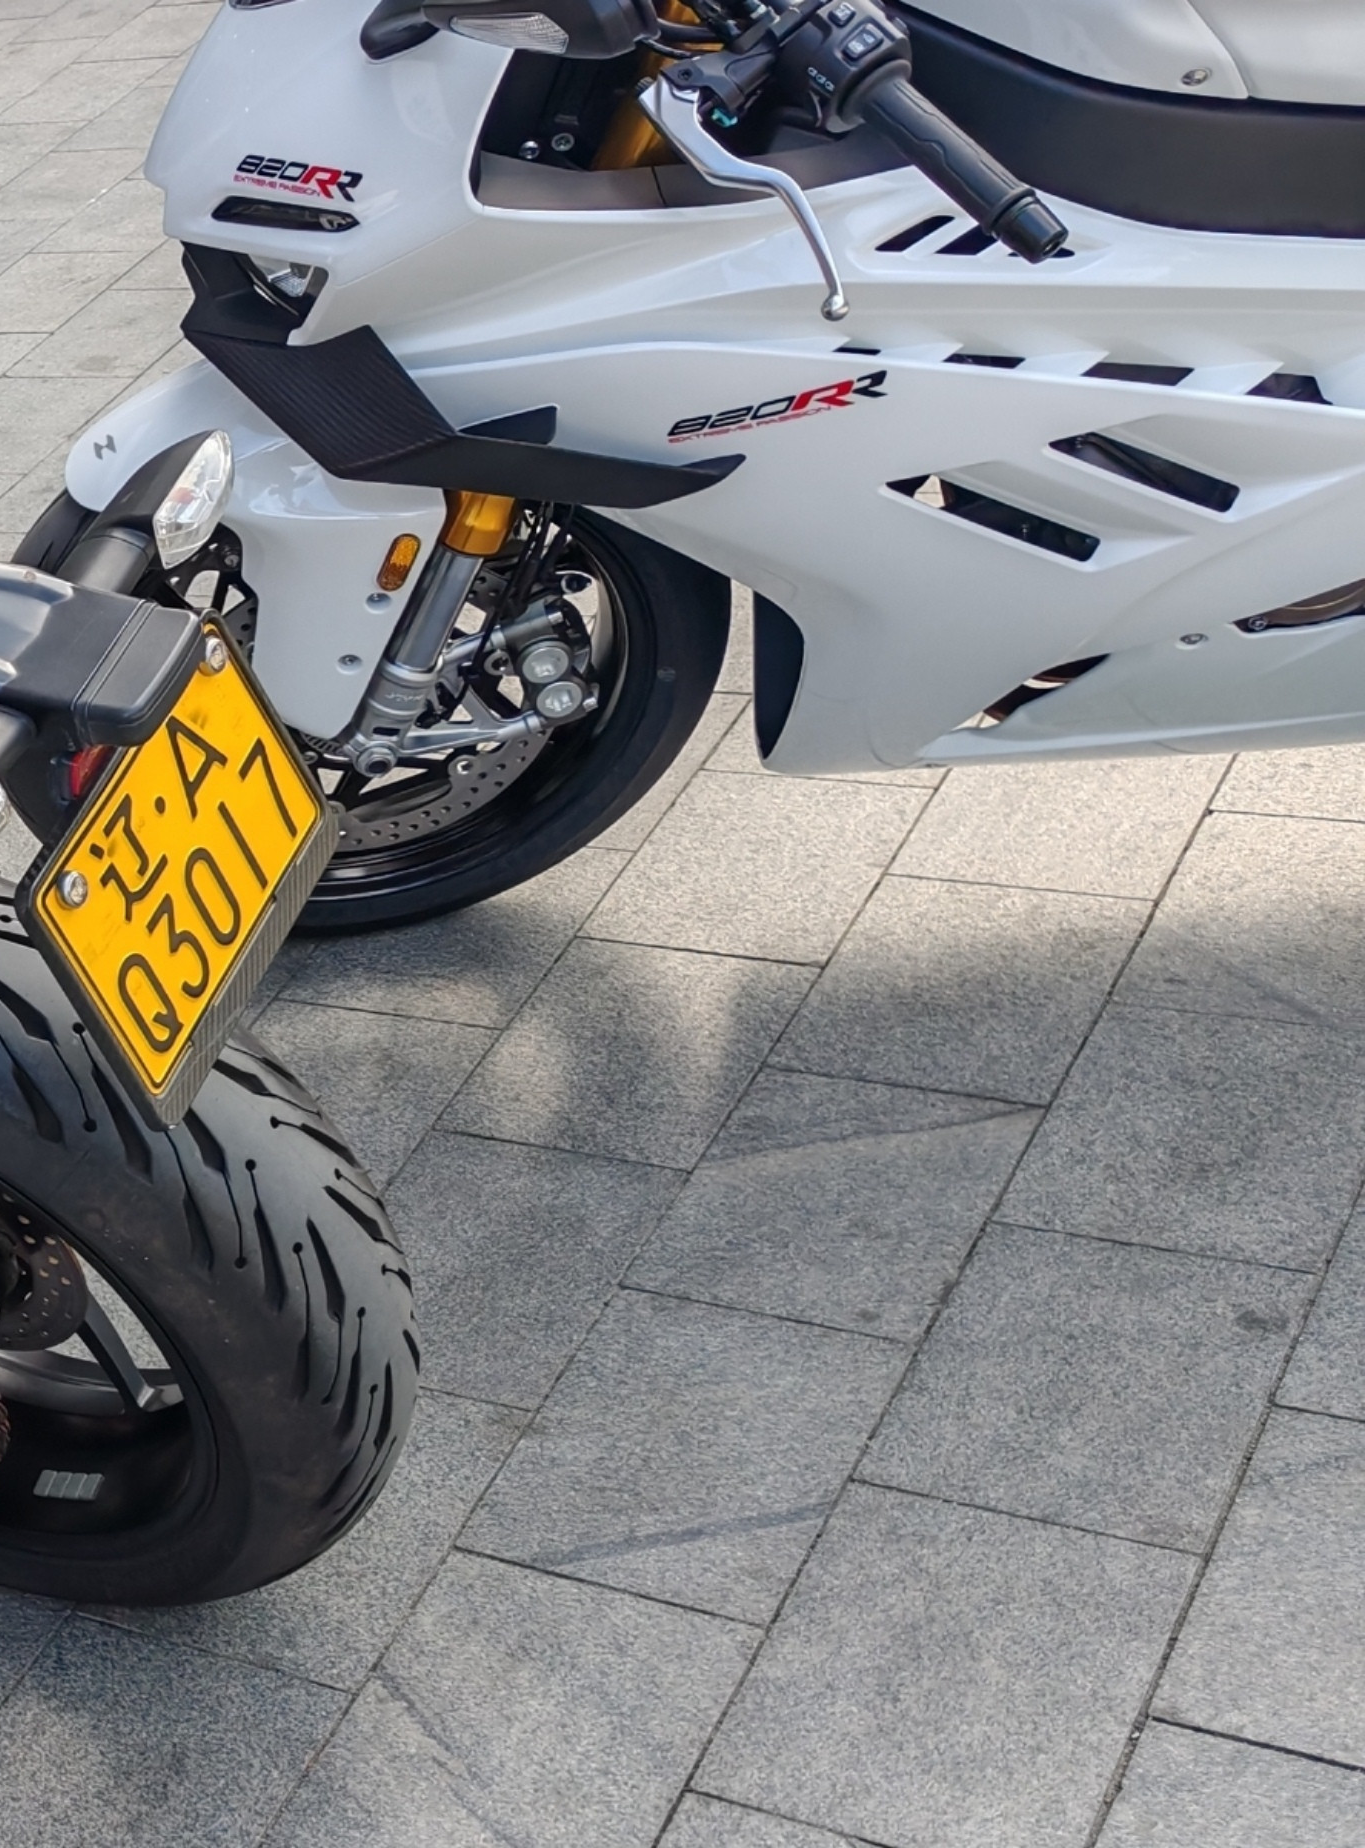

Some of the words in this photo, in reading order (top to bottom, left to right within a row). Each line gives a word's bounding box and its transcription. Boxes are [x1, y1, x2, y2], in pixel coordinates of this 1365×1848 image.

[235, 154, 363, 202] 820RR
[667, 370, 888, 437] 820RR
[117, 737, 298, 1054] Q3017
